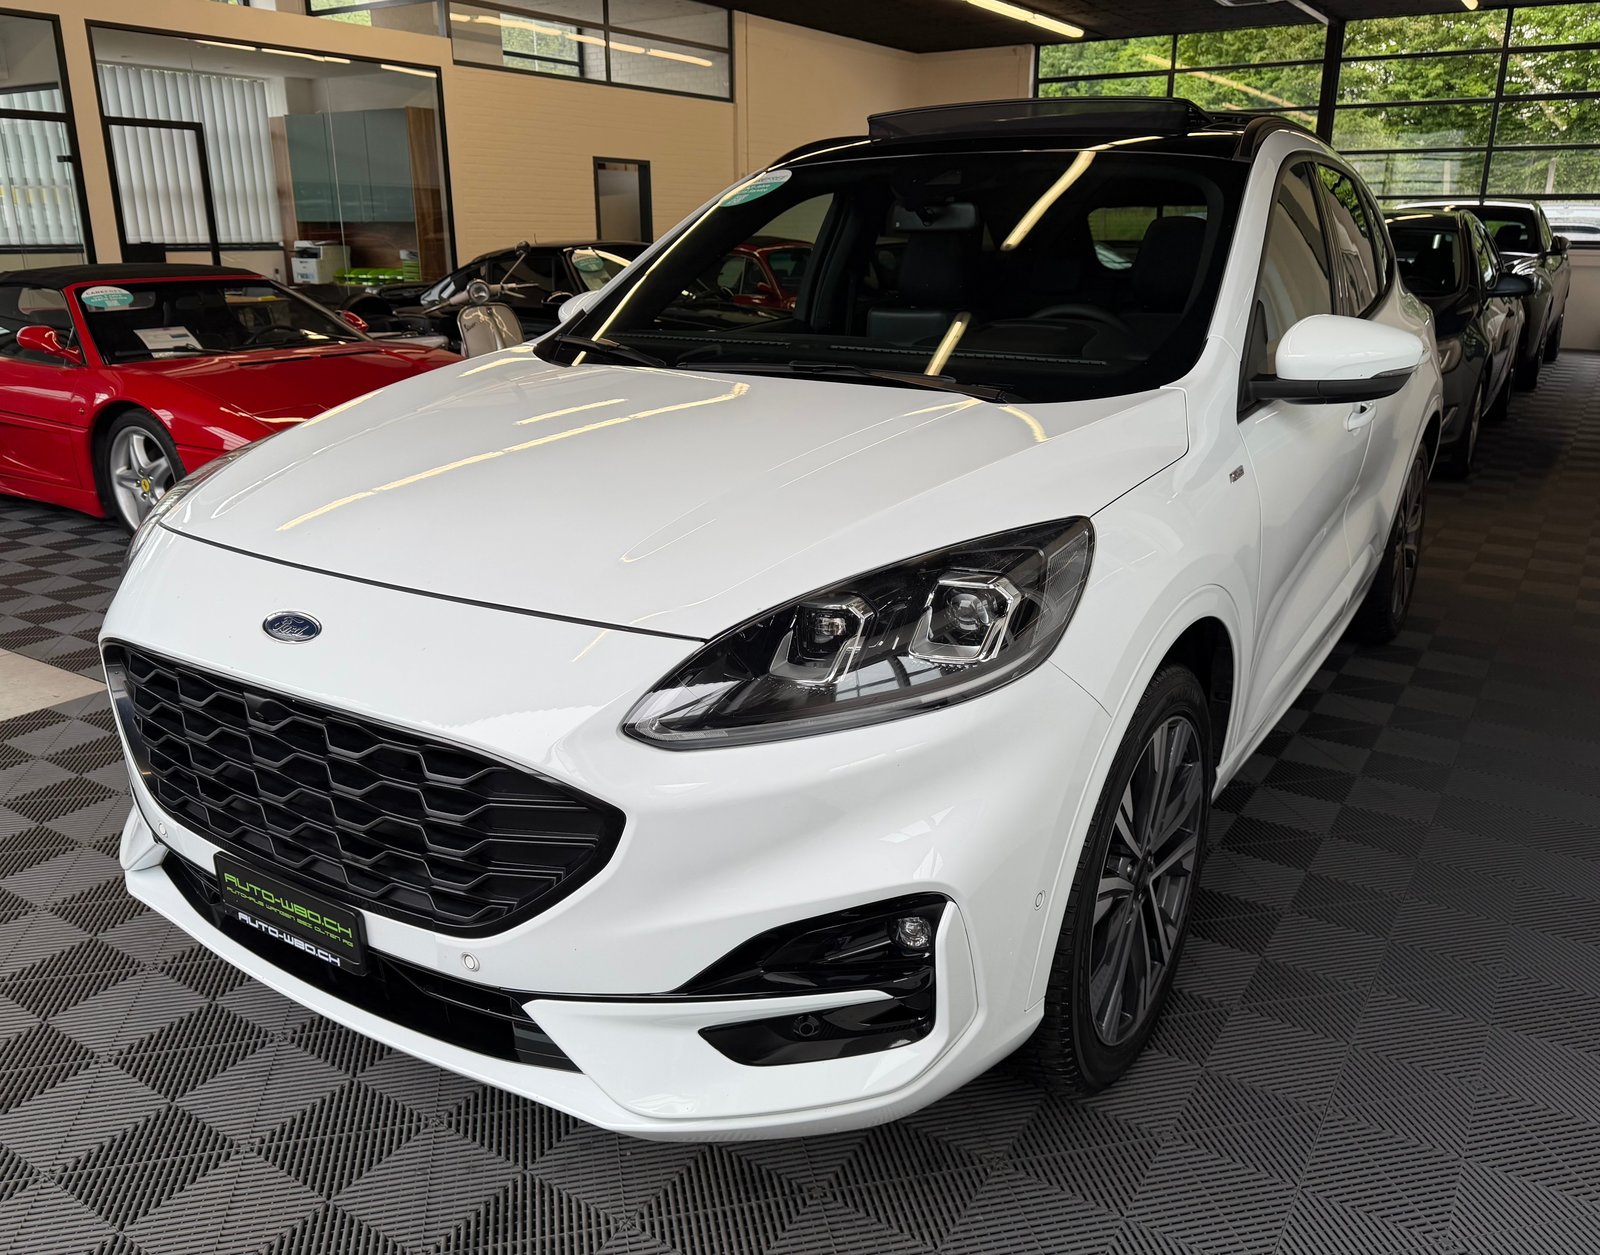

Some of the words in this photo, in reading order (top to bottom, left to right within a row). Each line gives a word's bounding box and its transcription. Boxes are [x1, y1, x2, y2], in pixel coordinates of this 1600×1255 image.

[271, 616, 310, 637] Ford
[226, 886, 265, 907] AUTOHAUS
[265, 903, 296, 922] WANGEN
[296, 917, 313, 929] BEI
[314, 925, 341, 942] OLTEN
[342, 938, 354, 948] AG
